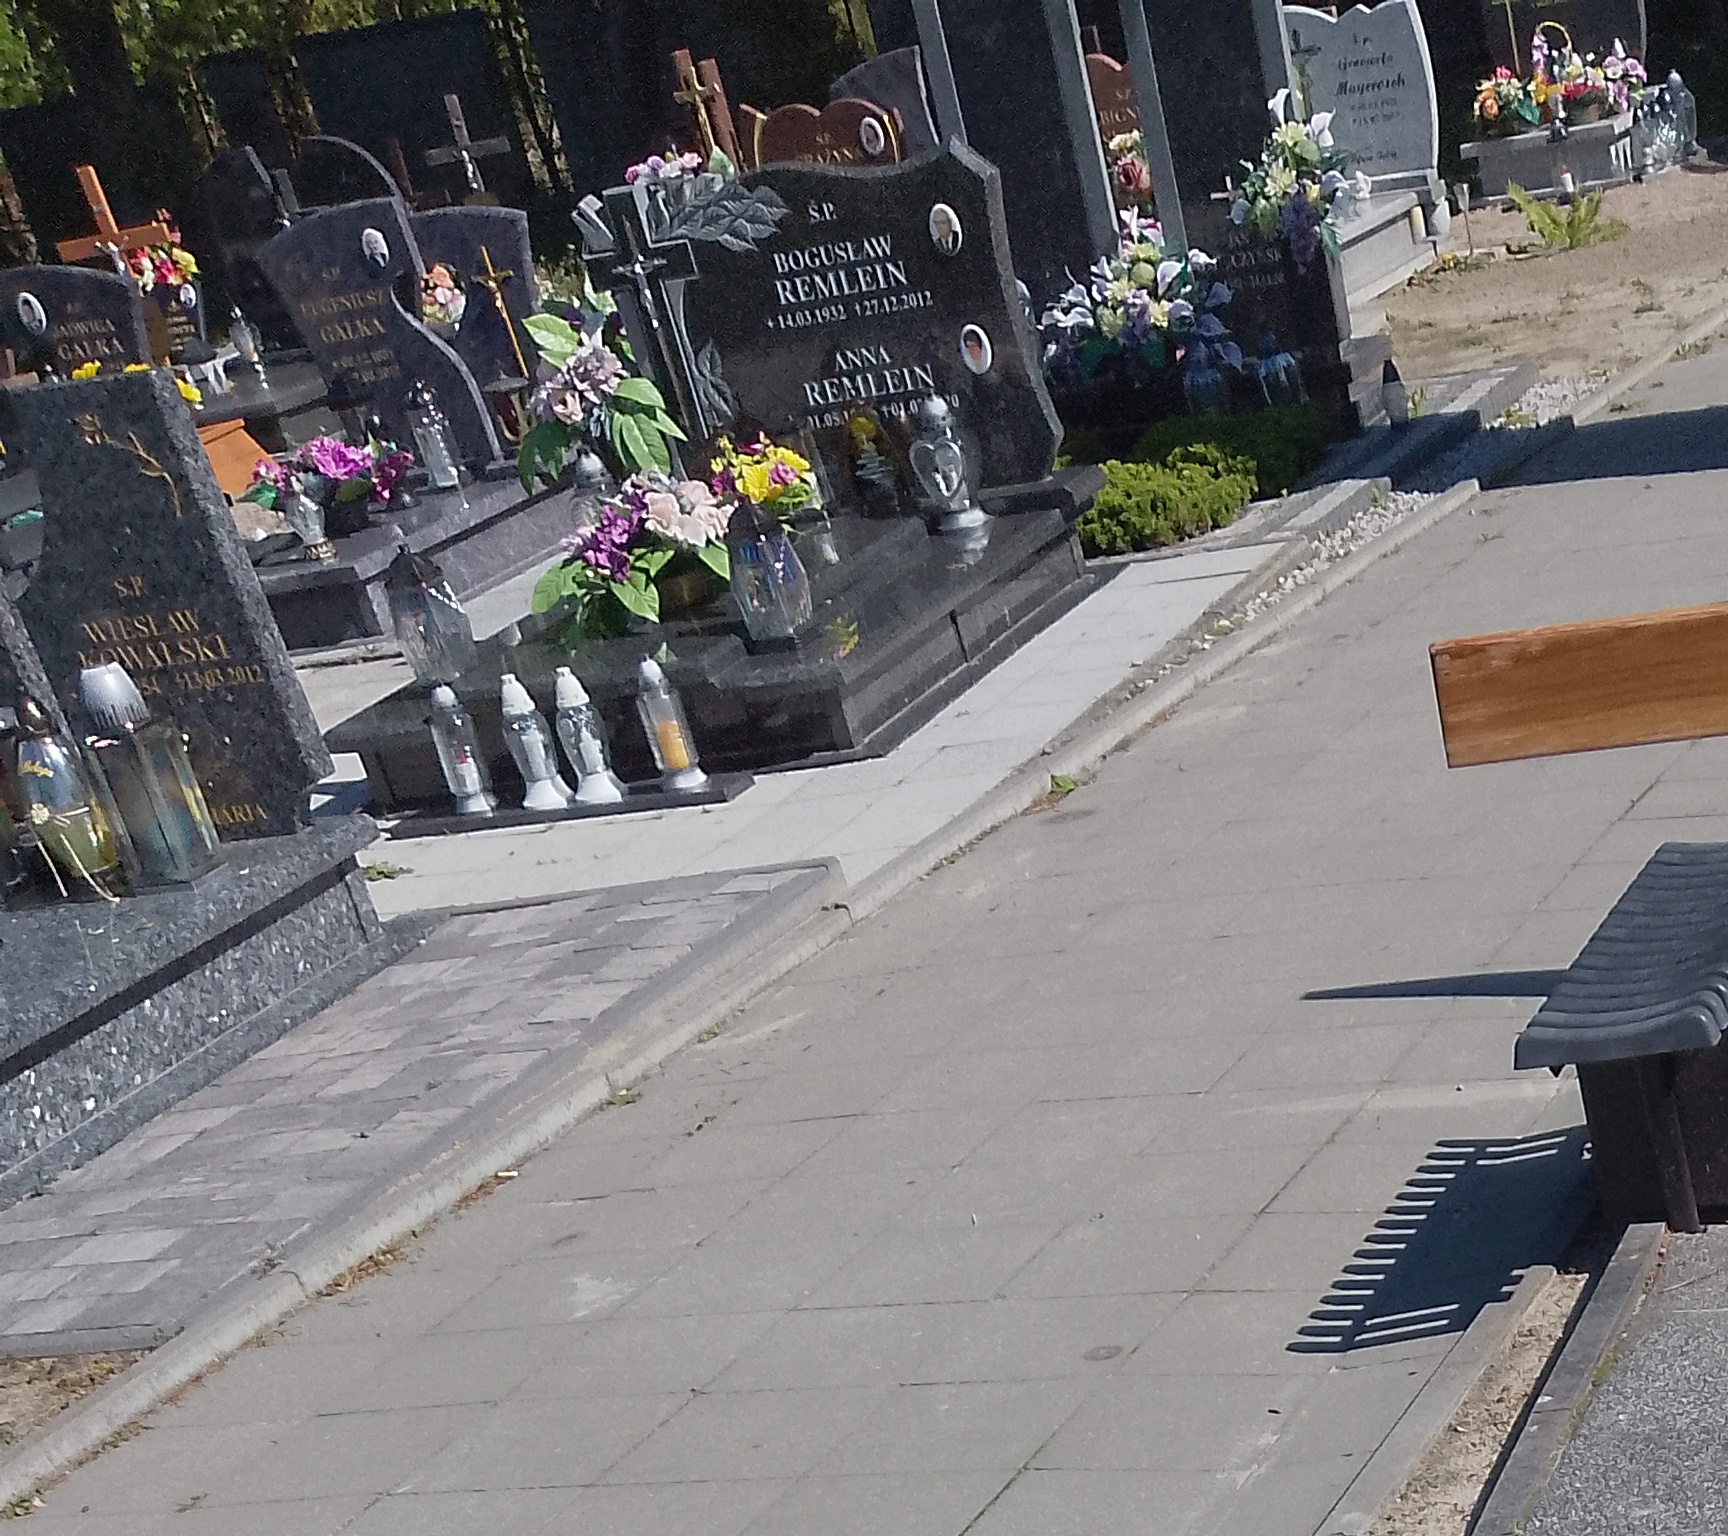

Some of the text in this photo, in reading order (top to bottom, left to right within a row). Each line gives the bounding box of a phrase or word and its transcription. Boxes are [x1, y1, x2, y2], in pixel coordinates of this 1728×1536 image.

[773, 234, 892, 274] BOGUSŁAW
[774, 260, 908, 305] REMLEIN
[834, 344, 892, 373] ANNA
[802, 363, 935, 407] REMLEIN
[77, 634, 231, 671] KOWALSKI
[210, 802, 268, 824] ARIA
